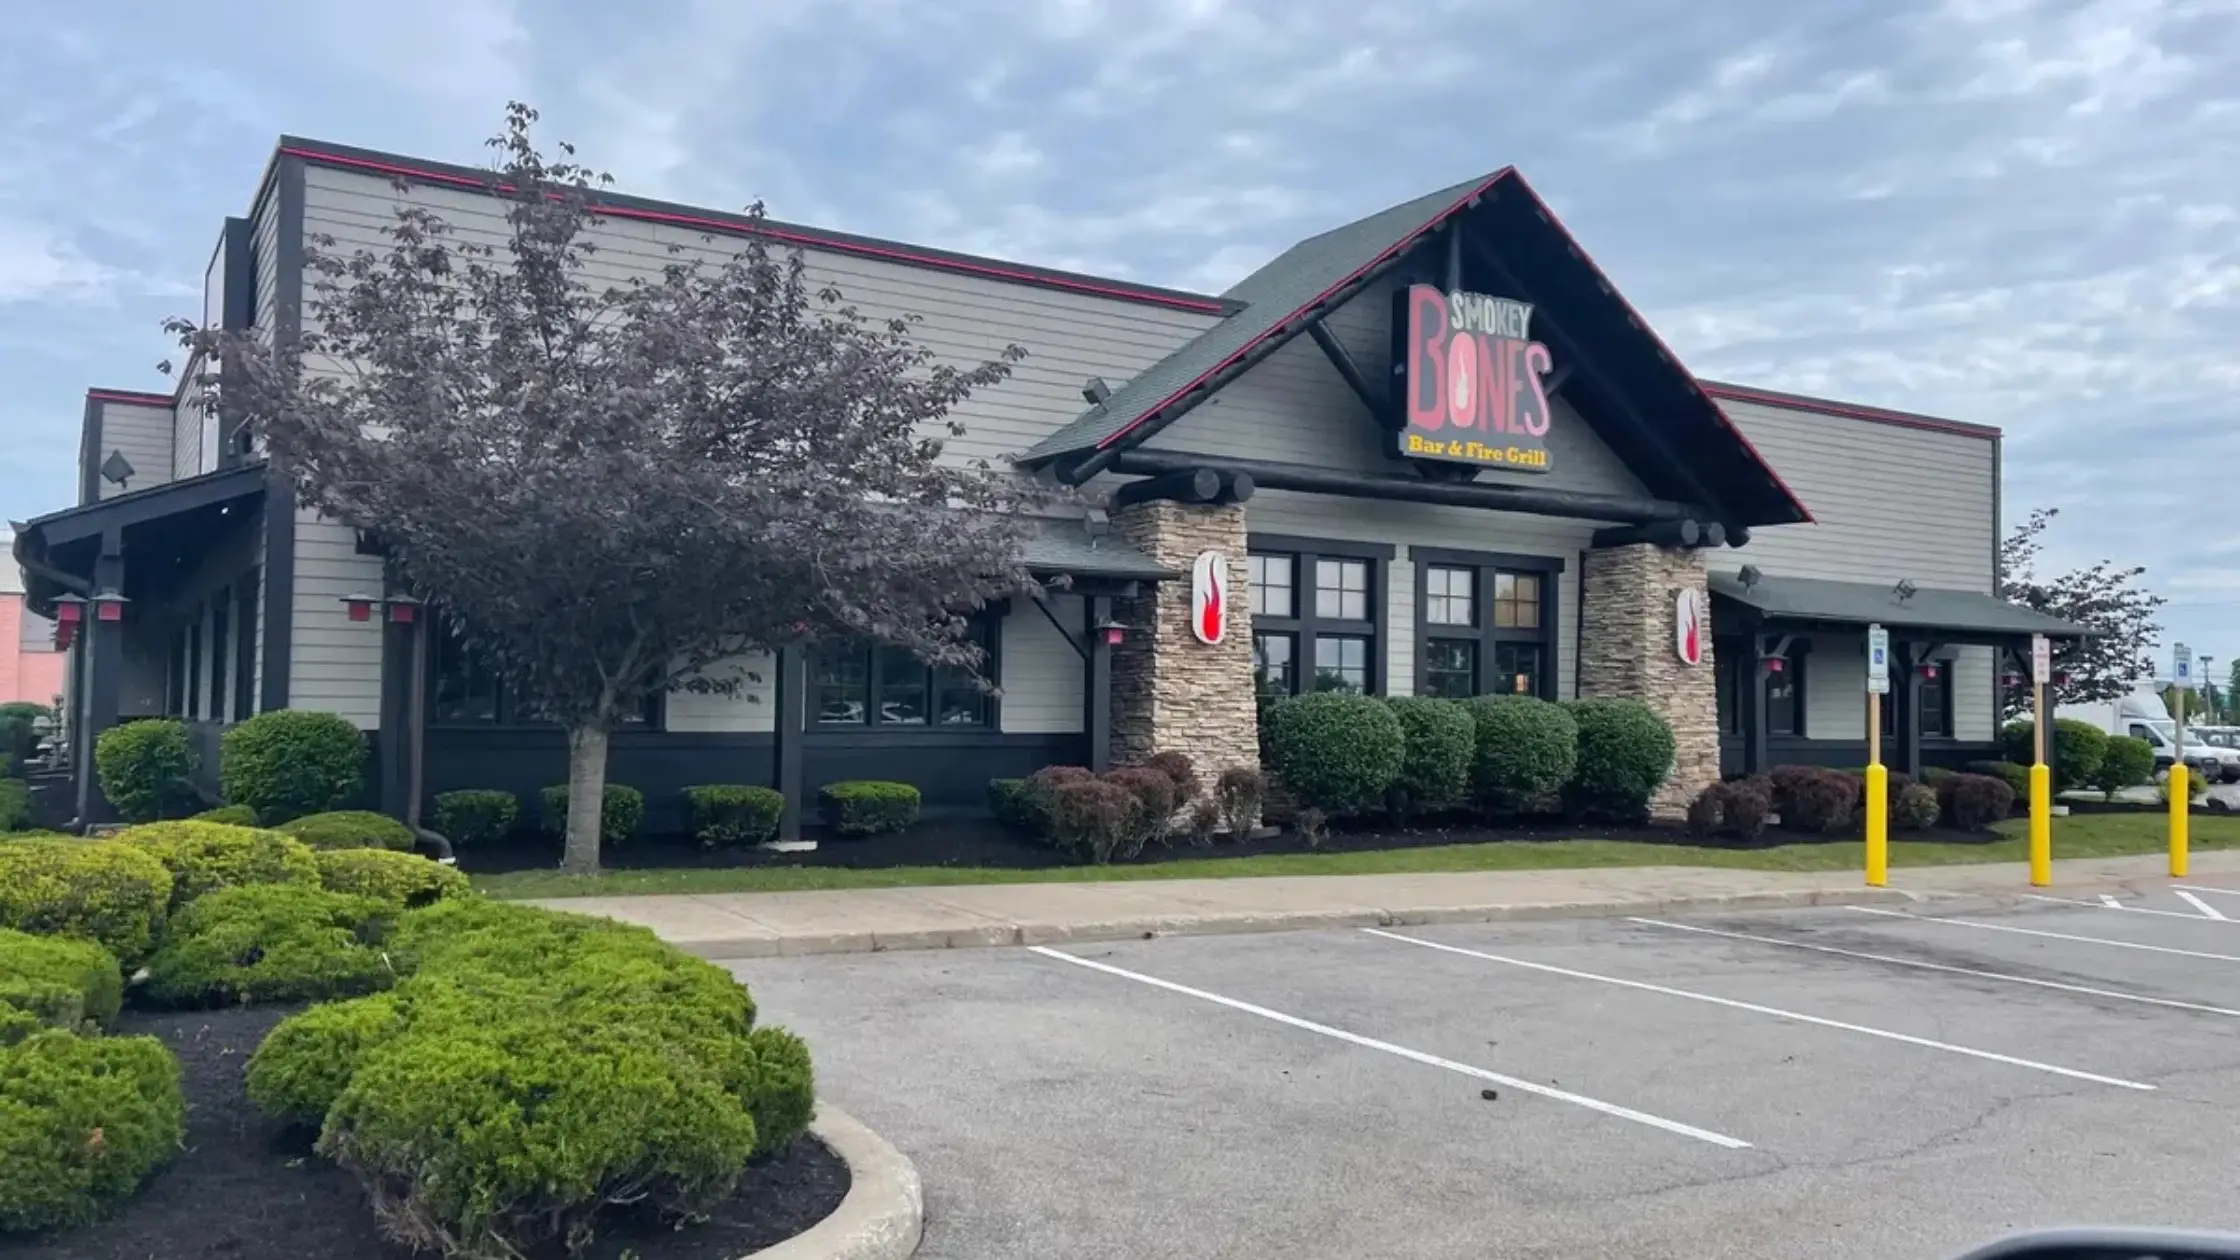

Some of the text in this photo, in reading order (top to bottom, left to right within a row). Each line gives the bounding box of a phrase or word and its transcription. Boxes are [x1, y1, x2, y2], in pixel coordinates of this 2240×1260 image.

[1450, 291, 1533, 340] SMOKEY
[1407, 283, 1552, 436] BONES
[1408, 434, 1546, 466] Bar & Fire Grill
